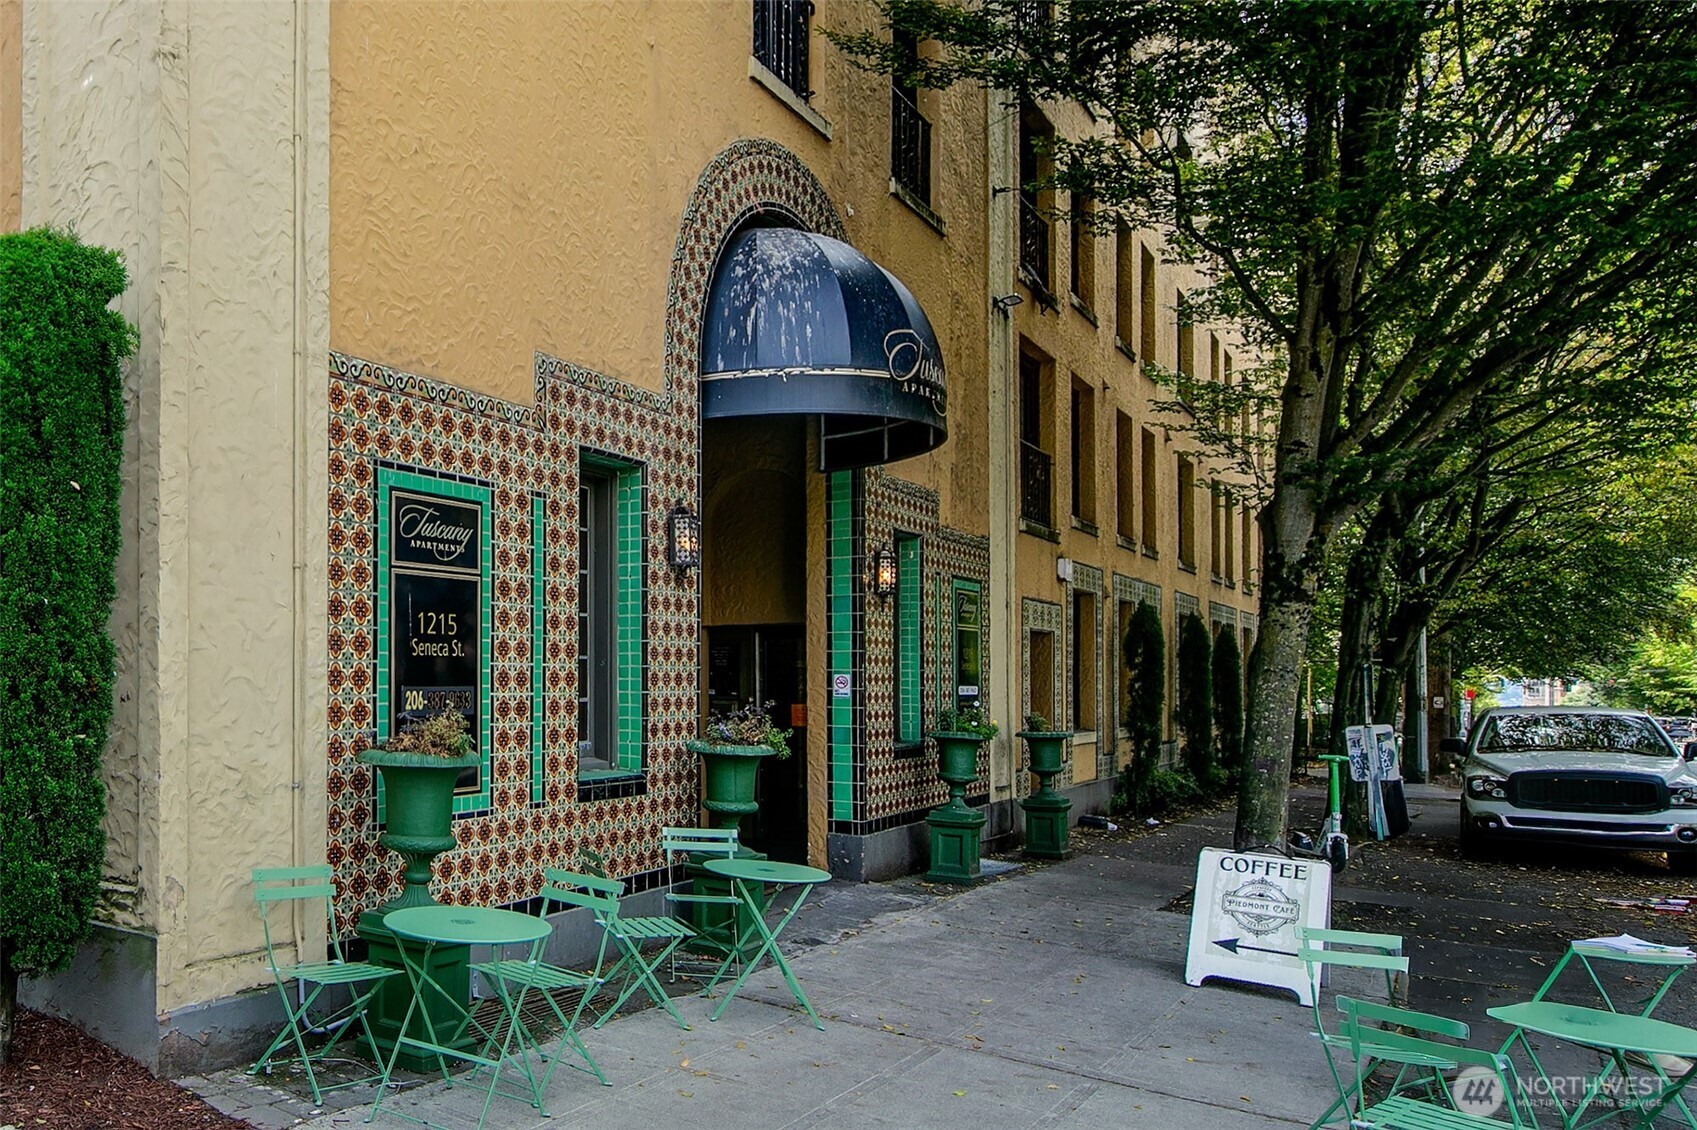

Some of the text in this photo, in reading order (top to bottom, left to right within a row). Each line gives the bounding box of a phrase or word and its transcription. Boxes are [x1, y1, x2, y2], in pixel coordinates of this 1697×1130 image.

[399, 504, 474, 561] Tuscany
[410, 539, 465, 553] APARTMENTS
[418, 611, 458, 636] 1215
[411, 638, 465, 657] Seneca St.
[1219, 856, 1308, 881] COFFEE
[1226, 898, 1270, 911] PIEDMONT
